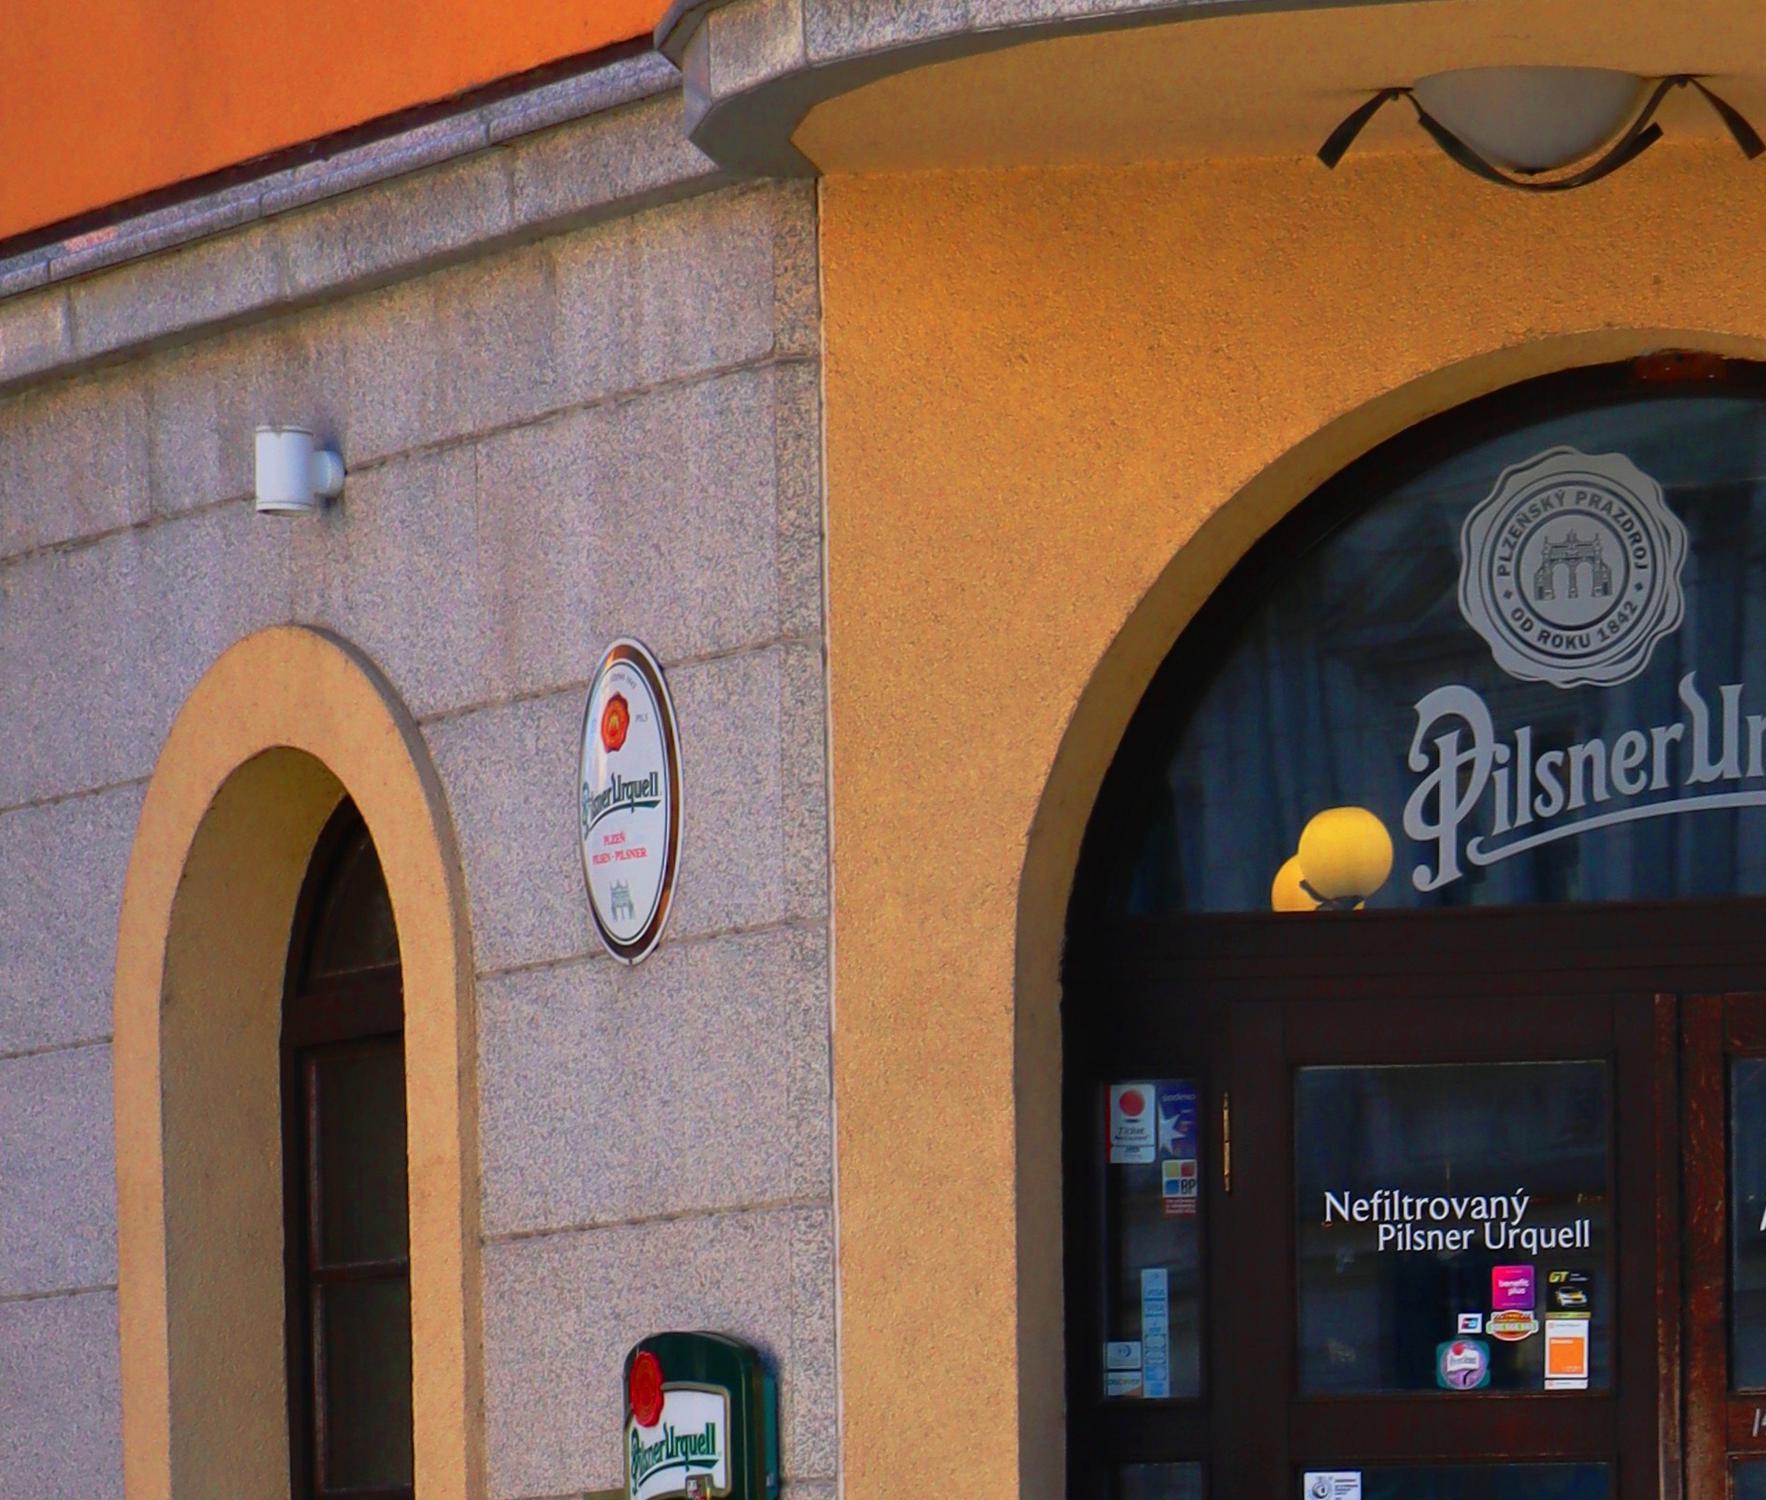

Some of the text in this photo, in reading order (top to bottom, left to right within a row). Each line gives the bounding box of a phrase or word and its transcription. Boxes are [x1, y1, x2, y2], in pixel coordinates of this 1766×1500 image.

[1497, 489, 1648, 577] PLZEŇSKÝ PRAZDROJ
[1511, 600, 1638, 650] OD ROKU 1842
[611, 771, 660, 813] Urquell
[1403, 684, 1685, 892] Pilsner
[1324, 1188, 1531, 1225] Nefiltrovaný
[1377, 1219, 1591, 1255] Pilsner Urquell
[663, 1422, 717, 1472] Urquell
